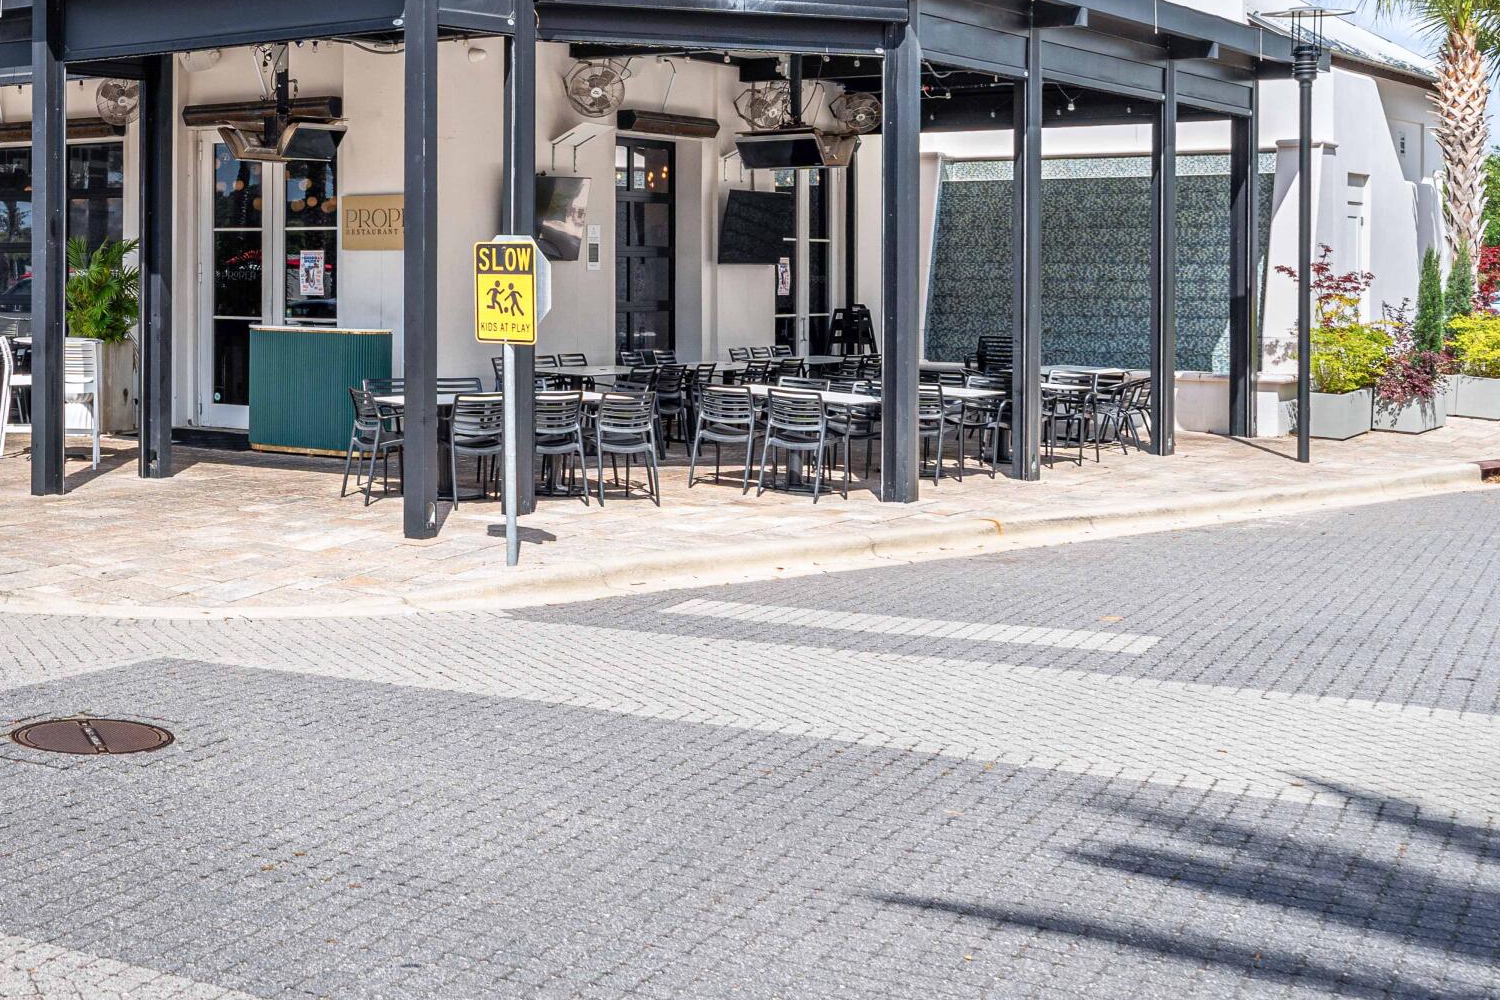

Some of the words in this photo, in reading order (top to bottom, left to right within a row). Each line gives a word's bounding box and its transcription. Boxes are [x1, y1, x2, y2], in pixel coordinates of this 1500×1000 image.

[345, 228, 399, 236] RESTAURANT
[479, 247, 531, 272] SLOW
[480, 322, 498, 332] KIDS
[500, 323, 509, 333] AT
[511, 323, 531, 333] PLAY
